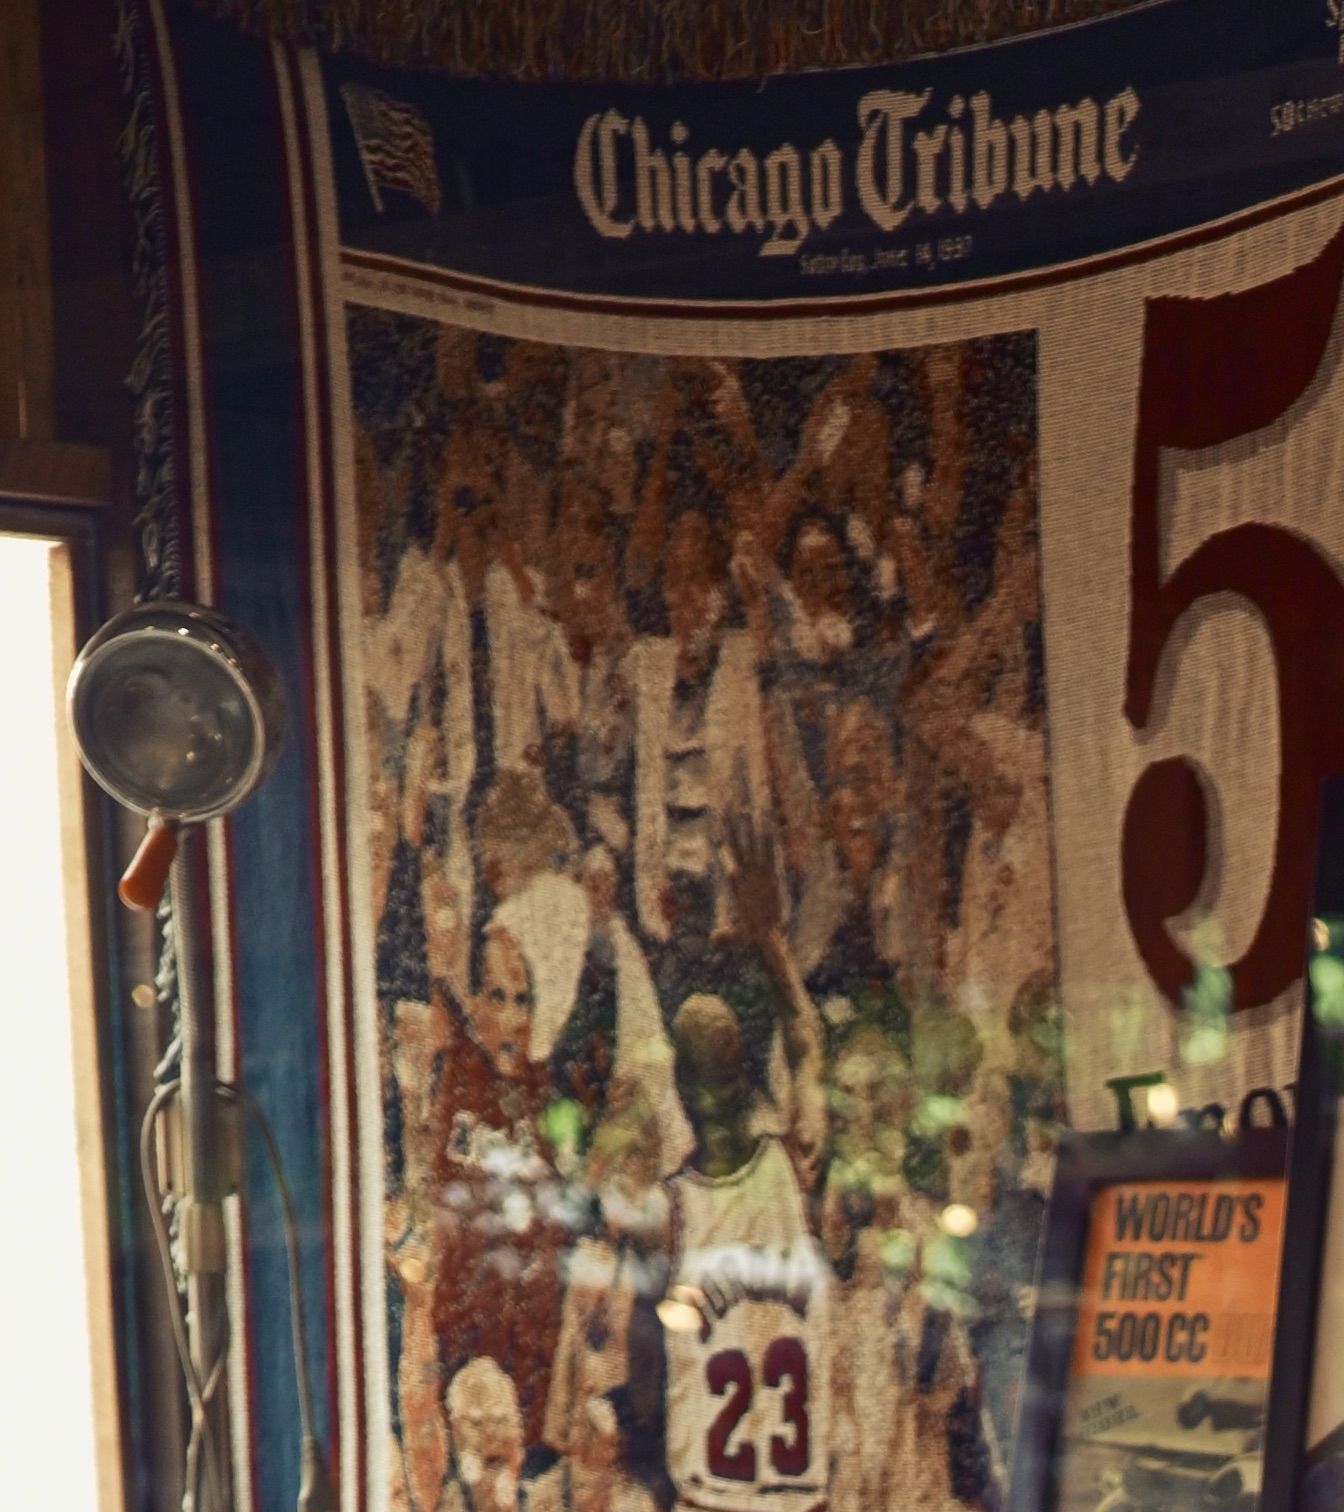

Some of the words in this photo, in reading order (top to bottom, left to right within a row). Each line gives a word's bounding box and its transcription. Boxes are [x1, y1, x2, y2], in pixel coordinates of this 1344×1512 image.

[573, 106, 845, 257] Chicago
[855, 85, 1140, 233] Tribune
[1115, 1191, 1262, 1243] WORLD'S
[1102, 1251, 1196, 1302] FIRST
[706, 1336, 809, 1482] 23
